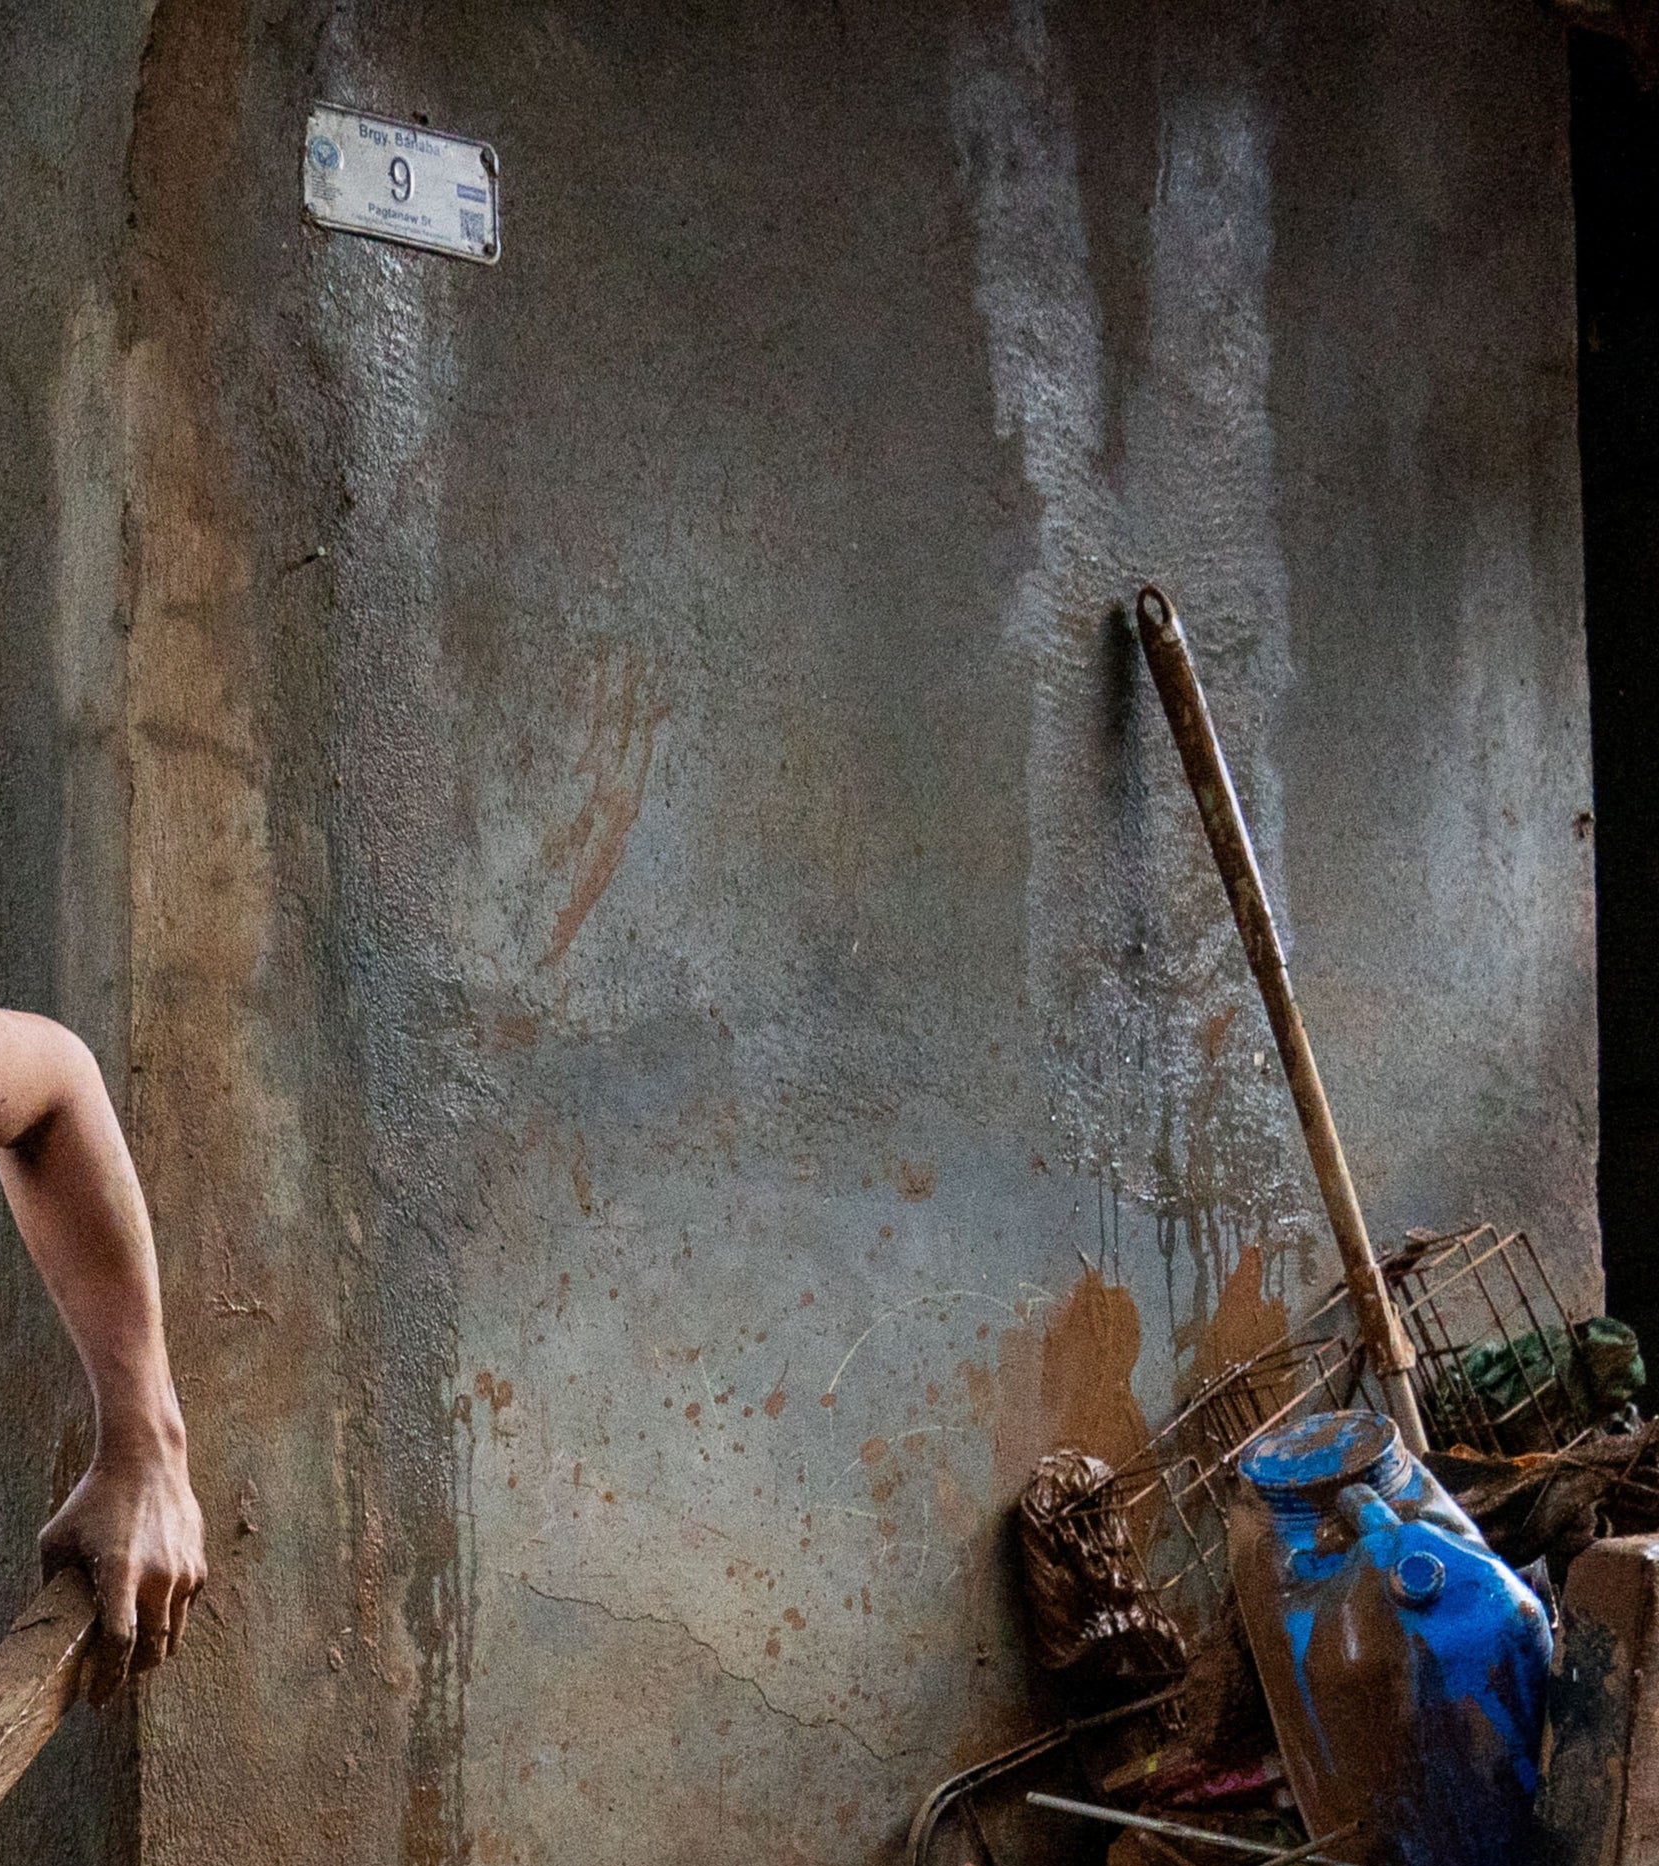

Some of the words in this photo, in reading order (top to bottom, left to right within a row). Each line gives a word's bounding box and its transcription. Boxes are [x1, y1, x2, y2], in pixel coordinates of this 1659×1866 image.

[359, 123, 391, 146] Brgy.
[395, 131, 440, 156] Banaba
[389, 156, 412, 203] 9
